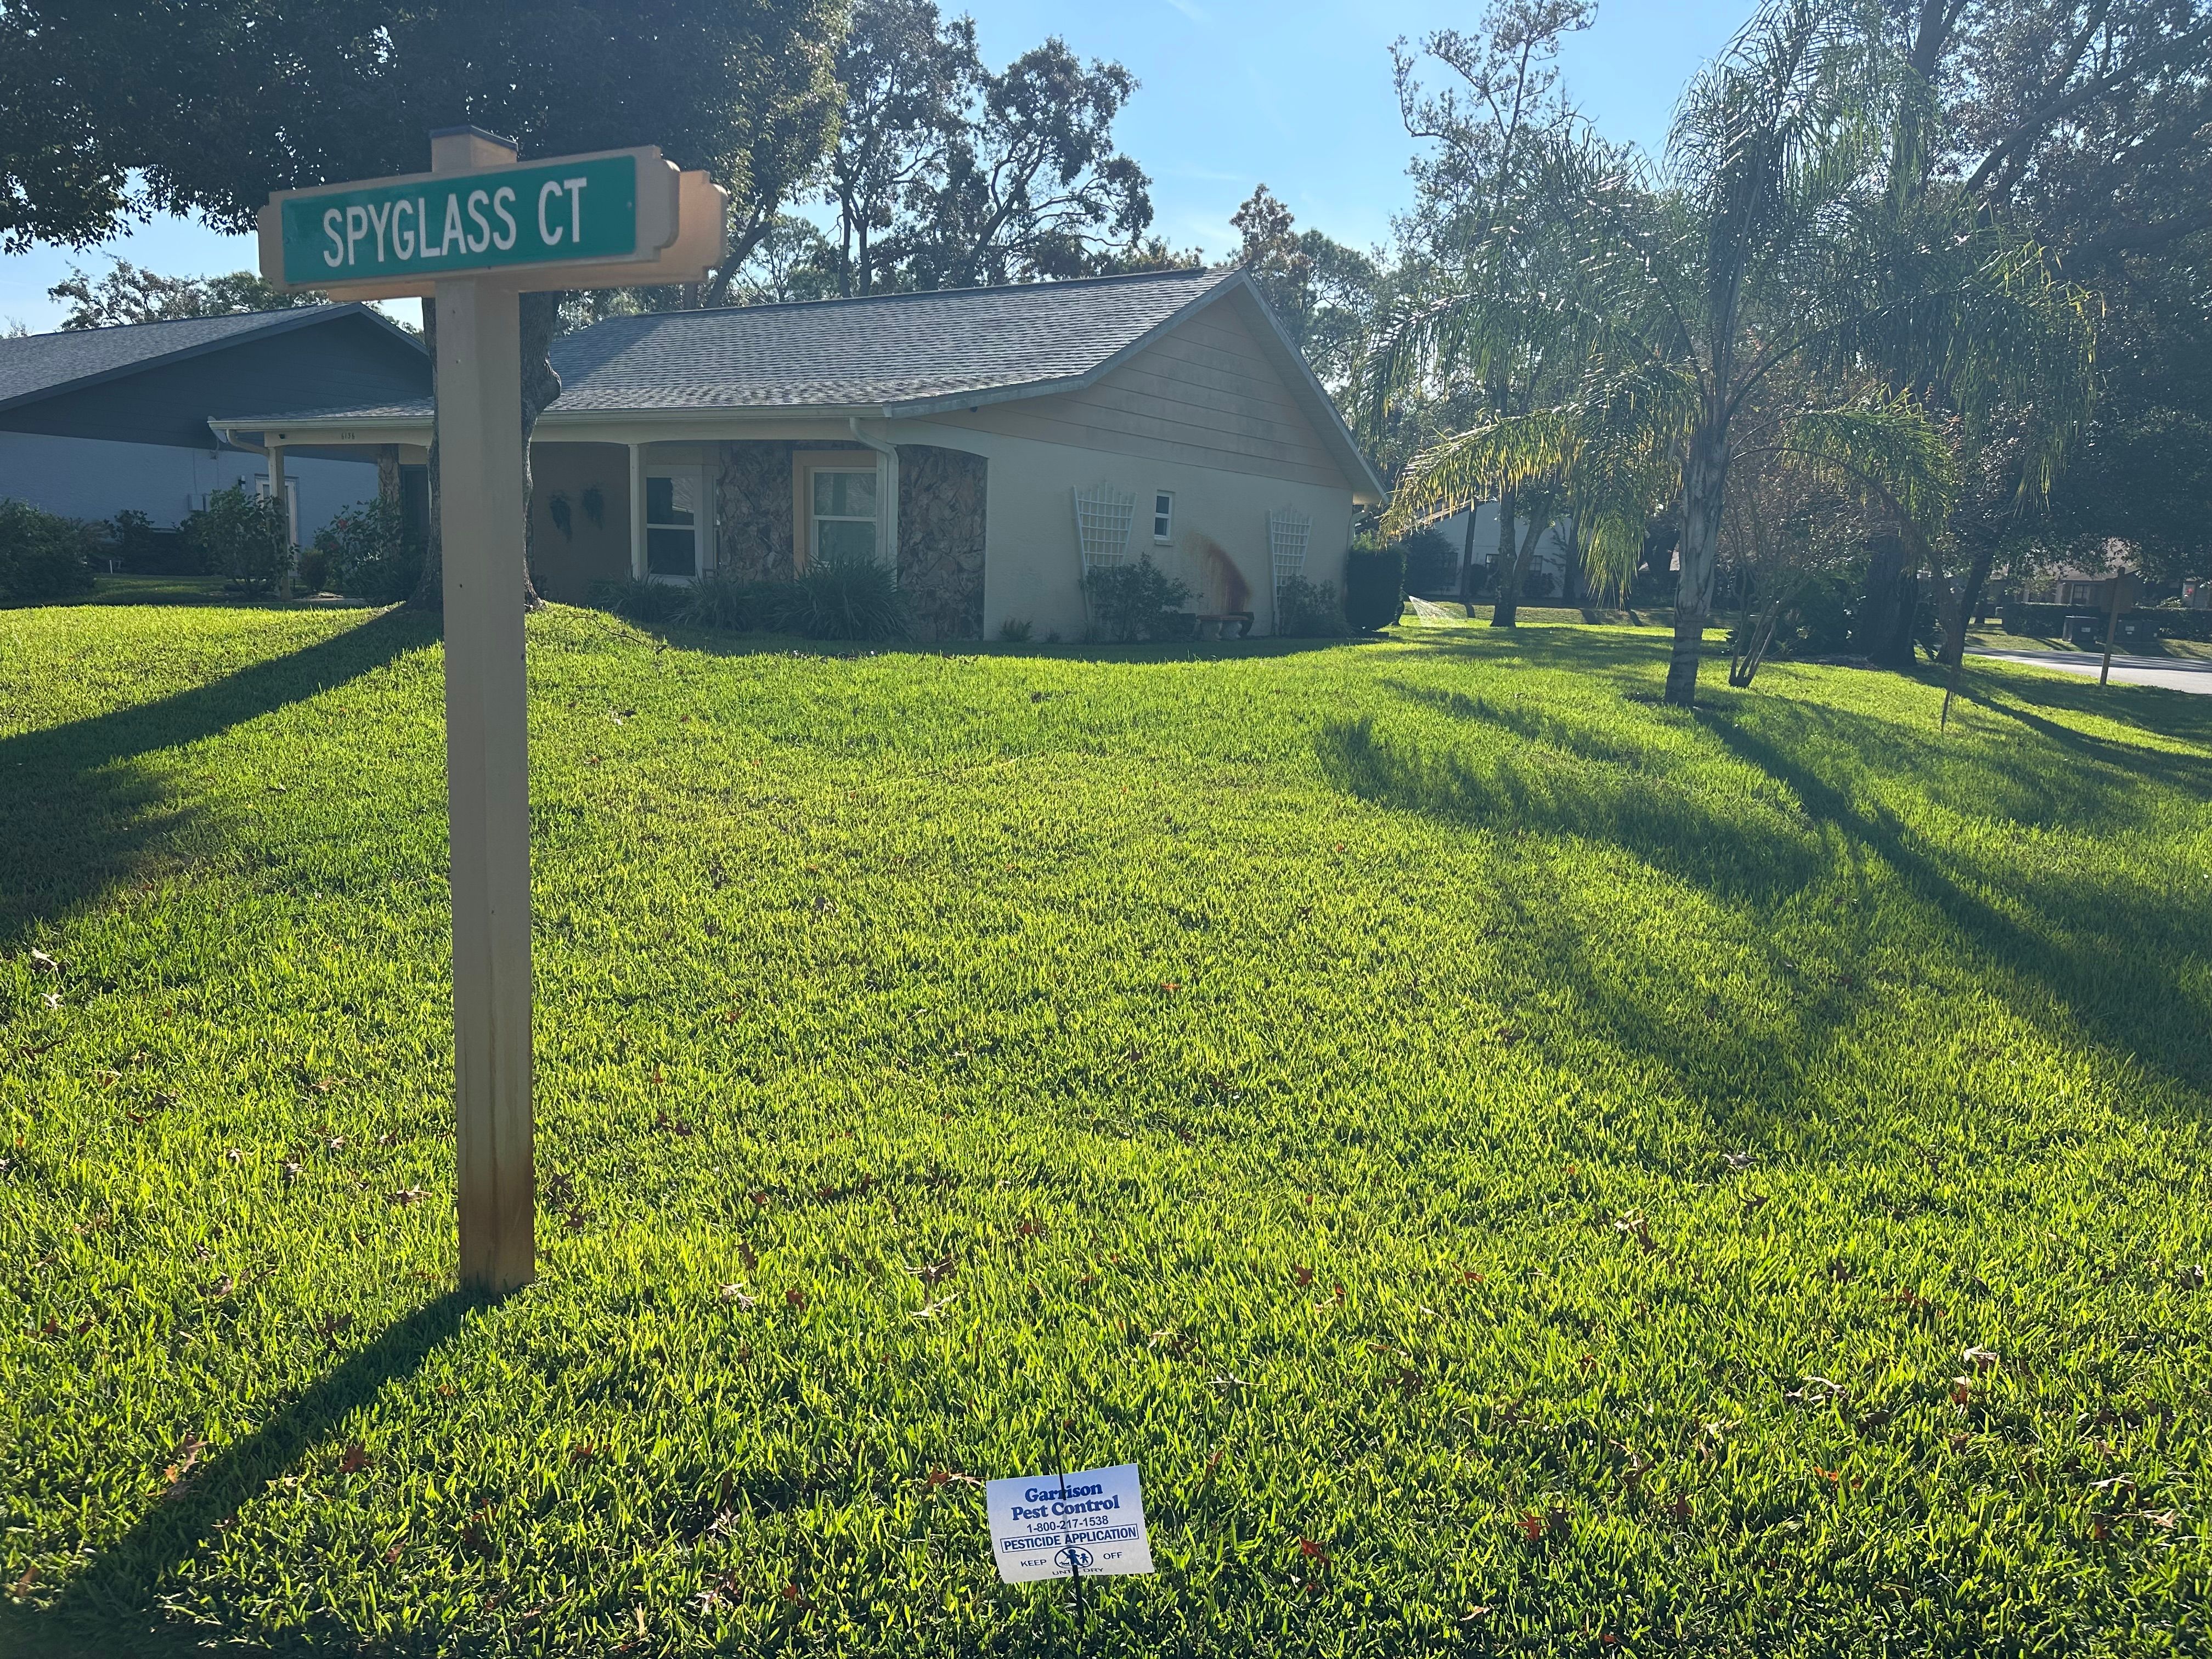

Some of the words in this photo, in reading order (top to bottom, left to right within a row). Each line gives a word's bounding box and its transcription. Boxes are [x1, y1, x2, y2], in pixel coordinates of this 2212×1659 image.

[323, 187, 517, 268] SPYGLASS
[538, 177, 587, 246] CT
[1025, 1483, 1103, 1502] Garrison
[1011, 1506, 1048, 1520] Pest
[1051, 1495, 1120, 1516] Control
[1026, 1515, 1109, 1533] 1-800-217-1538
[1004, 1536, 1062, 1551] PESTICIDE
[1065, 1527, 1136, 1544] APPLICATION
[1103, 1551, 1122, 1560] OFF
